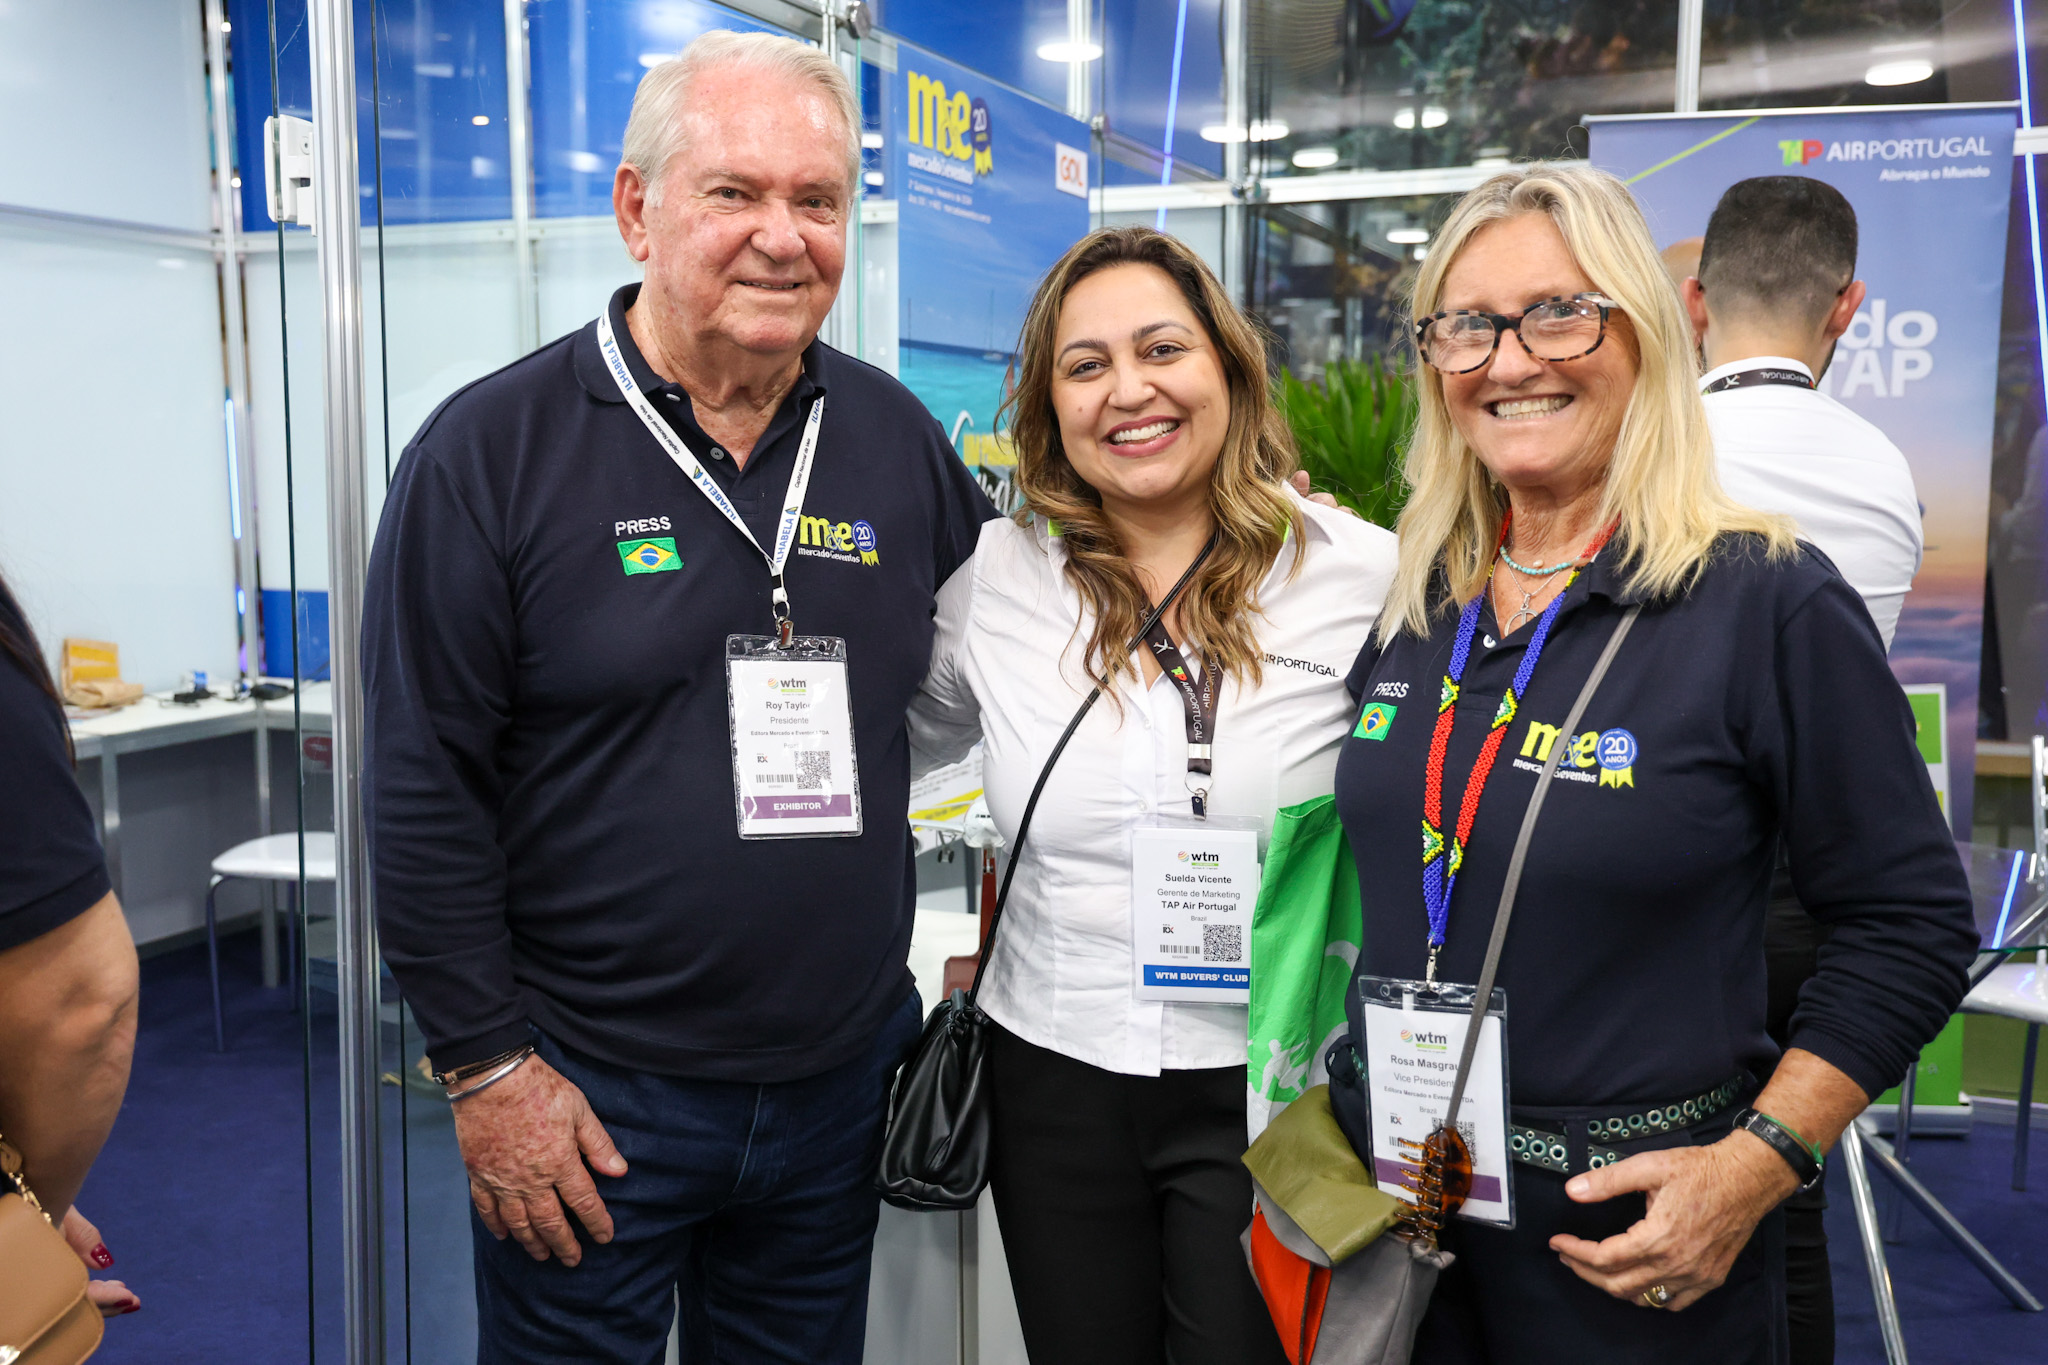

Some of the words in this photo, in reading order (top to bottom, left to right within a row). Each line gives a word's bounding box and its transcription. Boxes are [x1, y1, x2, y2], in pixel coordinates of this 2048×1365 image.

[973, 108, 987, 132] 20
[1778, 139, 1824, 166] TAP
[1060, 155, 1084, 187] GOL
[1879, 168, 1930, 182] Abraça
[1931, 170, 1941, 180] o
[1942, 166, 1991, 180] Mundo
[1839, 299, 1938, 349] do
[608, 346, 634, 392] ILHABELA
[651, 420, 669, 441] Nacional
[666, 438, 680, 455] Capital
[702, 478, 737, 521] ILHABELA
[615, 516, 672, 538] PRESS
[800, 514, 856, 552] m&e
[856, 526, 871, 541] 20
[776, 518, 794, 564] ILHABELA
[780, 678, 806, 688] wtm
[1372, 682, 1410, 698] PRESS
[766, 701, 783, 711] Roy
[770, 716, 809, 725] Presidente
[1604, 737, 1628, 755] 20
[1605, 755, 1628, 763] ANOS
[774, 802, 821, 811] EXHIBITOR
[1191, 852, 1219, 862] wtm
[1165, 874, 1196, 883] Suelda
[1198, 875, 1232, 884] Vicente
[1157, 888, 1188, 897] Gerente
[1190, 890, 1200, 898] de
[1202, 890, 1241, 900] Marketing
[1161, 901, 1180, 909] TAP
[1182, 902, 1196, 910] Air
[1198, 902, 1237, 912] Portugal
[1155, 972, 1178, 980] WTM
[1180, 972, 1220, 981] BUYERS'
[1223, 974, 1249, 982] CLUB
[1415, 1032, 1447, 1044] wtm
[1390, 1055, 1415, 1067] Rosa
[1394, 1072, 1412, 1083] Vice
[1413, 1075, 1455, 1088] President
[1384, 1086, 1402, 1095] Editora
[1404, 1090, 1427, 1099] Mercado
[1420, 1106, 1437, 1114] Brazil
